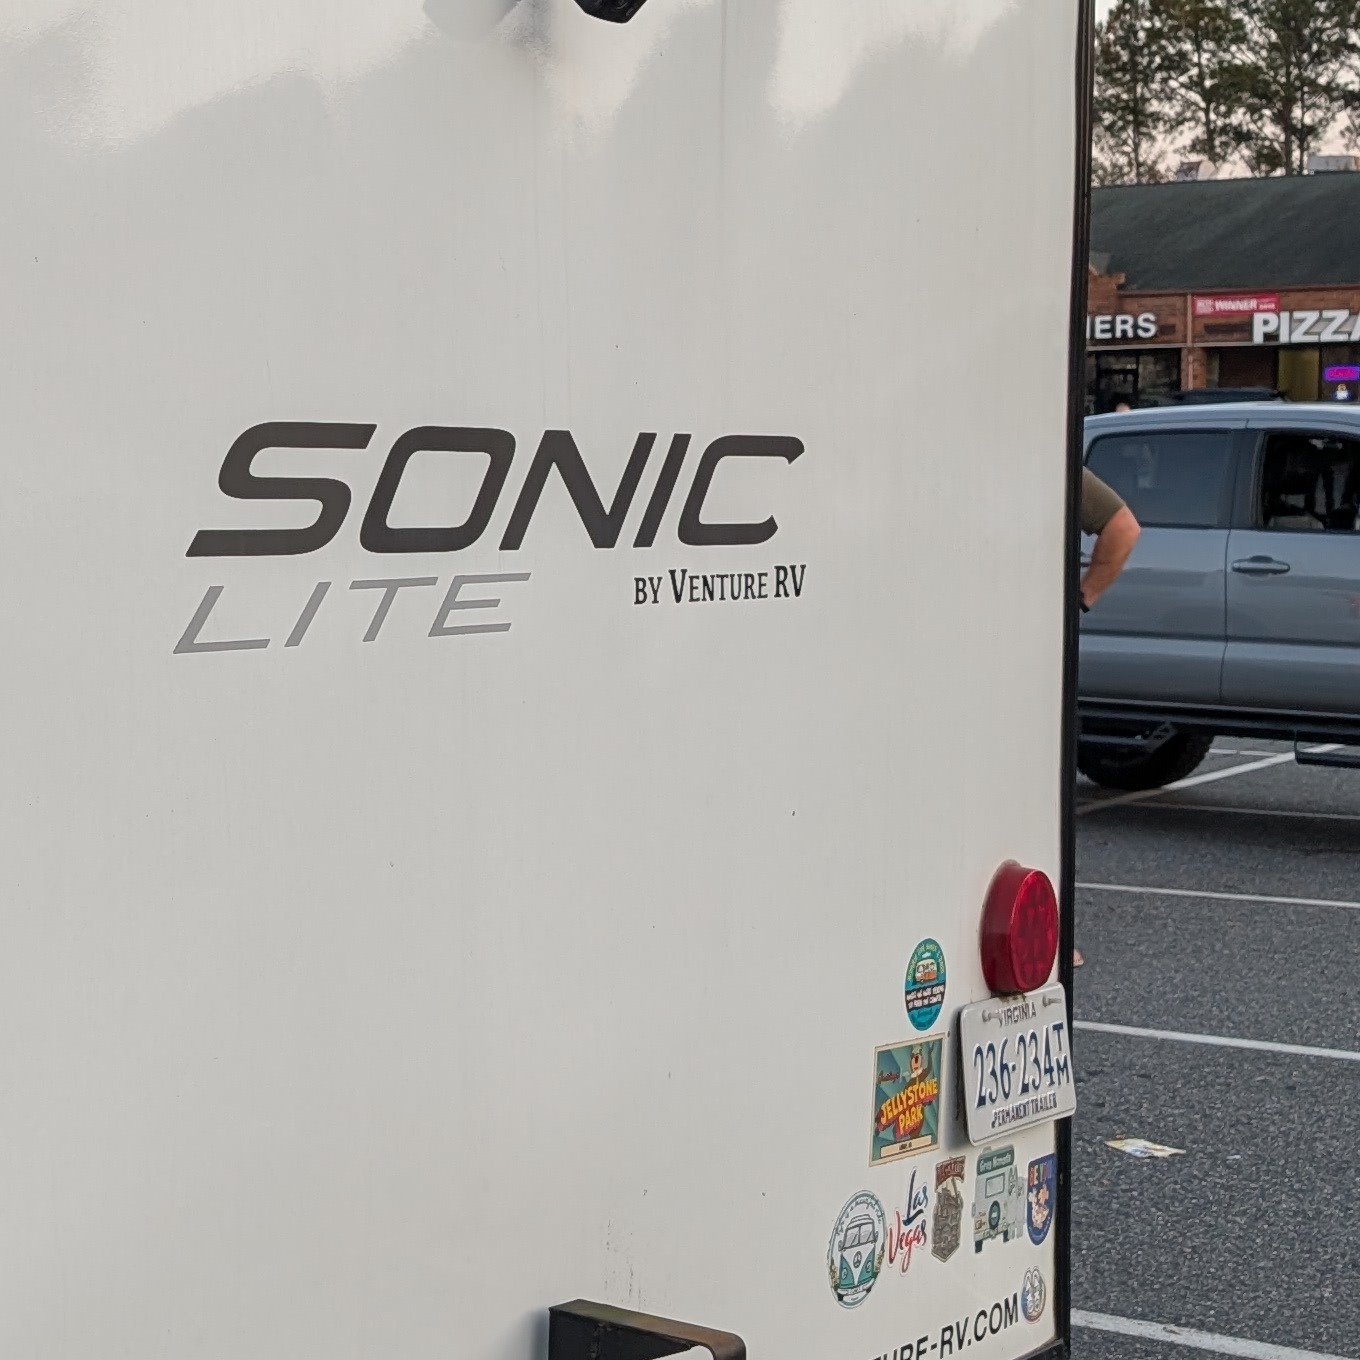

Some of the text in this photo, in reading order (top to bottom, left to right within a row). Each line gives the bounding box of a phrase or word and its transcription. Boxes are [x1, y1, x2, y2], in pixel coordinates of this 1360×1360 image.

[1086, 312, 1157, 339] ERS
[1253, 309, 1360, 343] PIZZ
[185, 421, 805, 557] SONIC
[774, 564, 806, 598] RV
[173, 572, 531, 655] LITE
[995, 1001, 1037, 1027] VIRGINIA
[881, 1078, 938, 1125] JELLYSTONE
[898, 1104, 924, 1134] PARK
[902, 1166, 929, 1226] Las
[888, 1210, 928, 1273] Vegas
